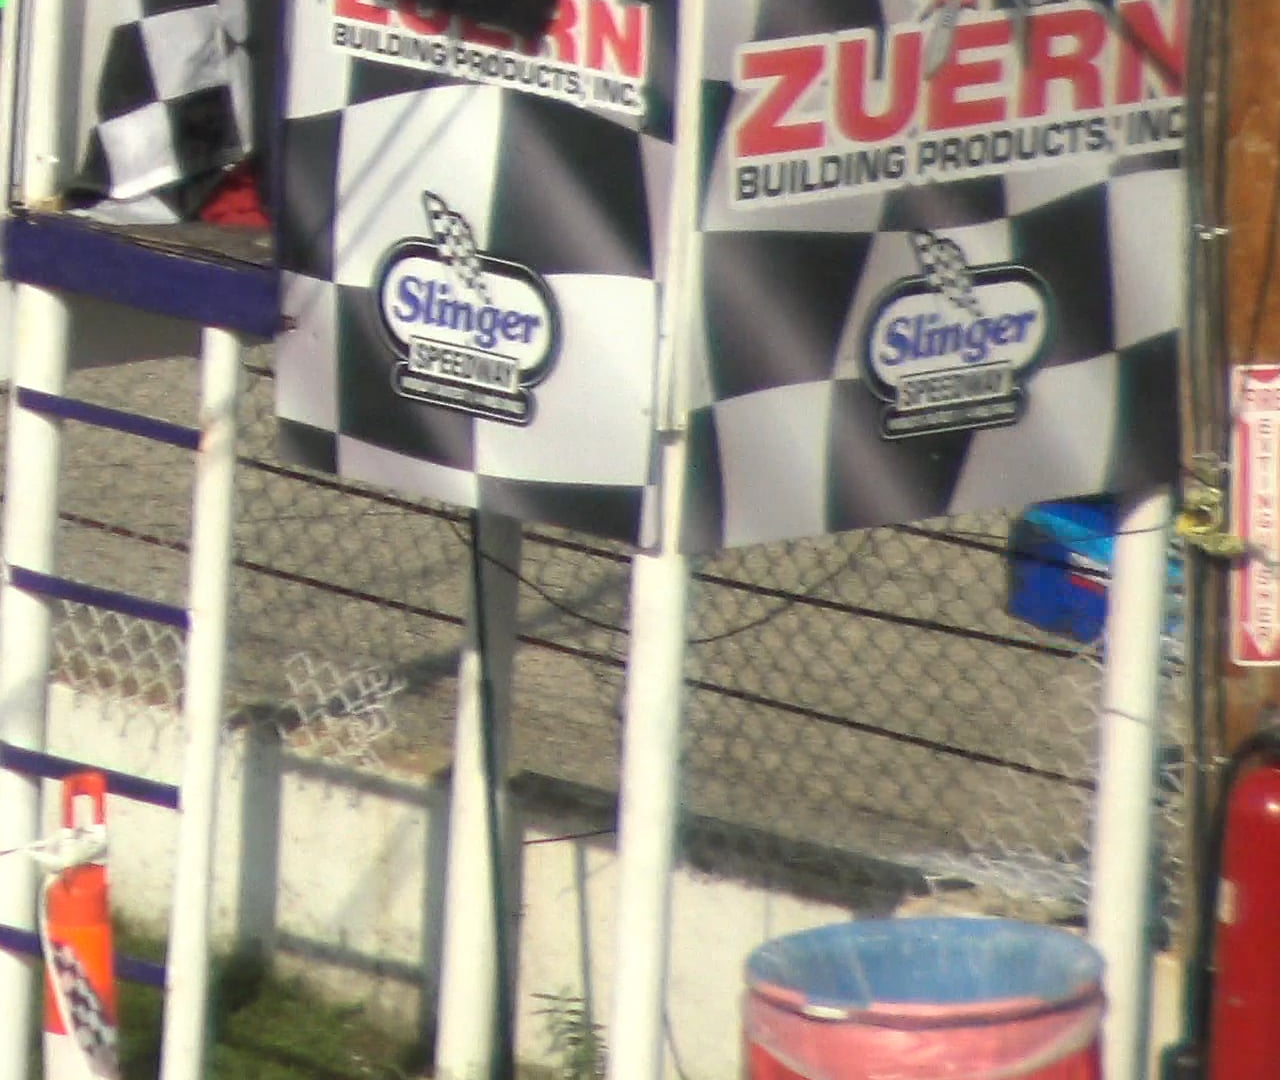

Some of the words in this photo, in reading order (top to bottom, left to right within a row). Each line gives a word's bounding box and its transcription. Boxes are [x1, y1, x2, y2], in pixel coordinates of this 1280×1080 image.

[333, 22, 446, 67] BUILDING
[454, 47, 586, 100] PRODUCTS,
[736, 145, 905, 201] BUILDING
[918, 119, 1116, 178] PRODUCTS,
[393, 275, 543, 349] Slinger
[880, 310, 1038, 366] Slinger
